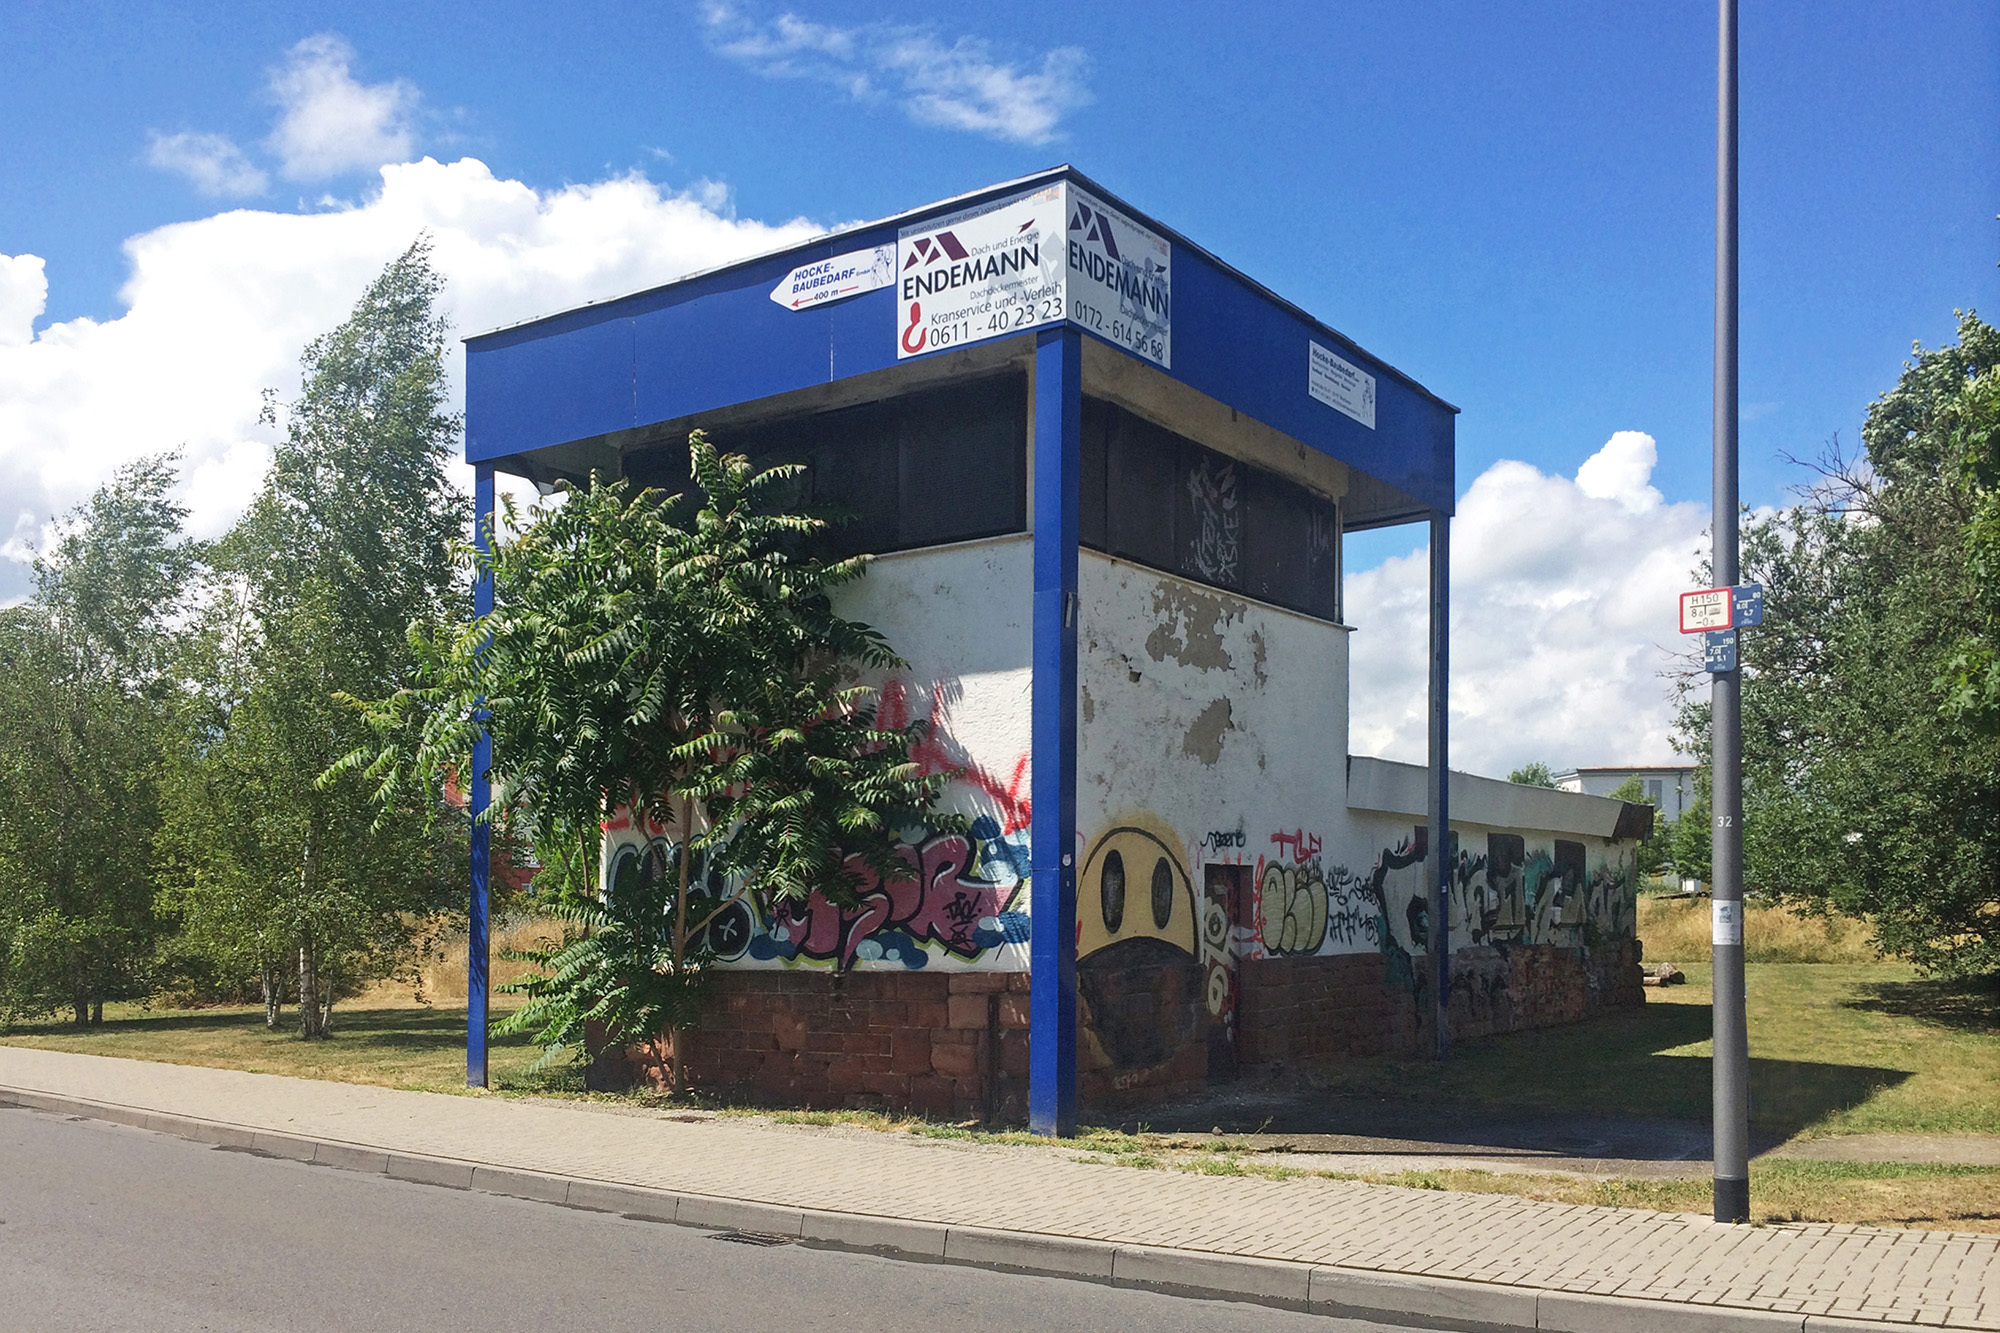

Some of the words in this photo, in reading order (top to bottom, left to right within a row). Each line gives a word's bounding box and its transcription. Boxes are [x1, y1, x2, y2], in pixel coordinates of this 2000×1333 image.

[971, 244, 990, 257] Dach
[992, 238, 1008, 251] und
[1009, 231, 1039, 246] Energie
[792, 268, 856, 294] BAUBEDARF
[794, 262, 834, 282] HOCKE-
[903, 243, 1039, 301] ENDEMANN
[1069, 239, 1168, 319] ENDEMANN
[813, 291, 829, 301] 400
[970, 275, 1039, 300] Dachdeckermeister
[931, 302, 992, 326] Kranservice
[994, 291, 1017, 310] und
[1020, 281, 1062, 302] -Verleih
[930, 321, 969, 347] 0611
[987, 311, 1009, 332] 40
[1014, 304, 1035, 327] 23
[1042, 297, 1063, 320] 23
[1075, 300, 1102, 331] 0172
[1113, 320, 1132, 345] 614
[1135, 331, 1148, 353] 56
[1151, 339, 1163, 361] 68
[1717, 815, 1733, 828] 32
